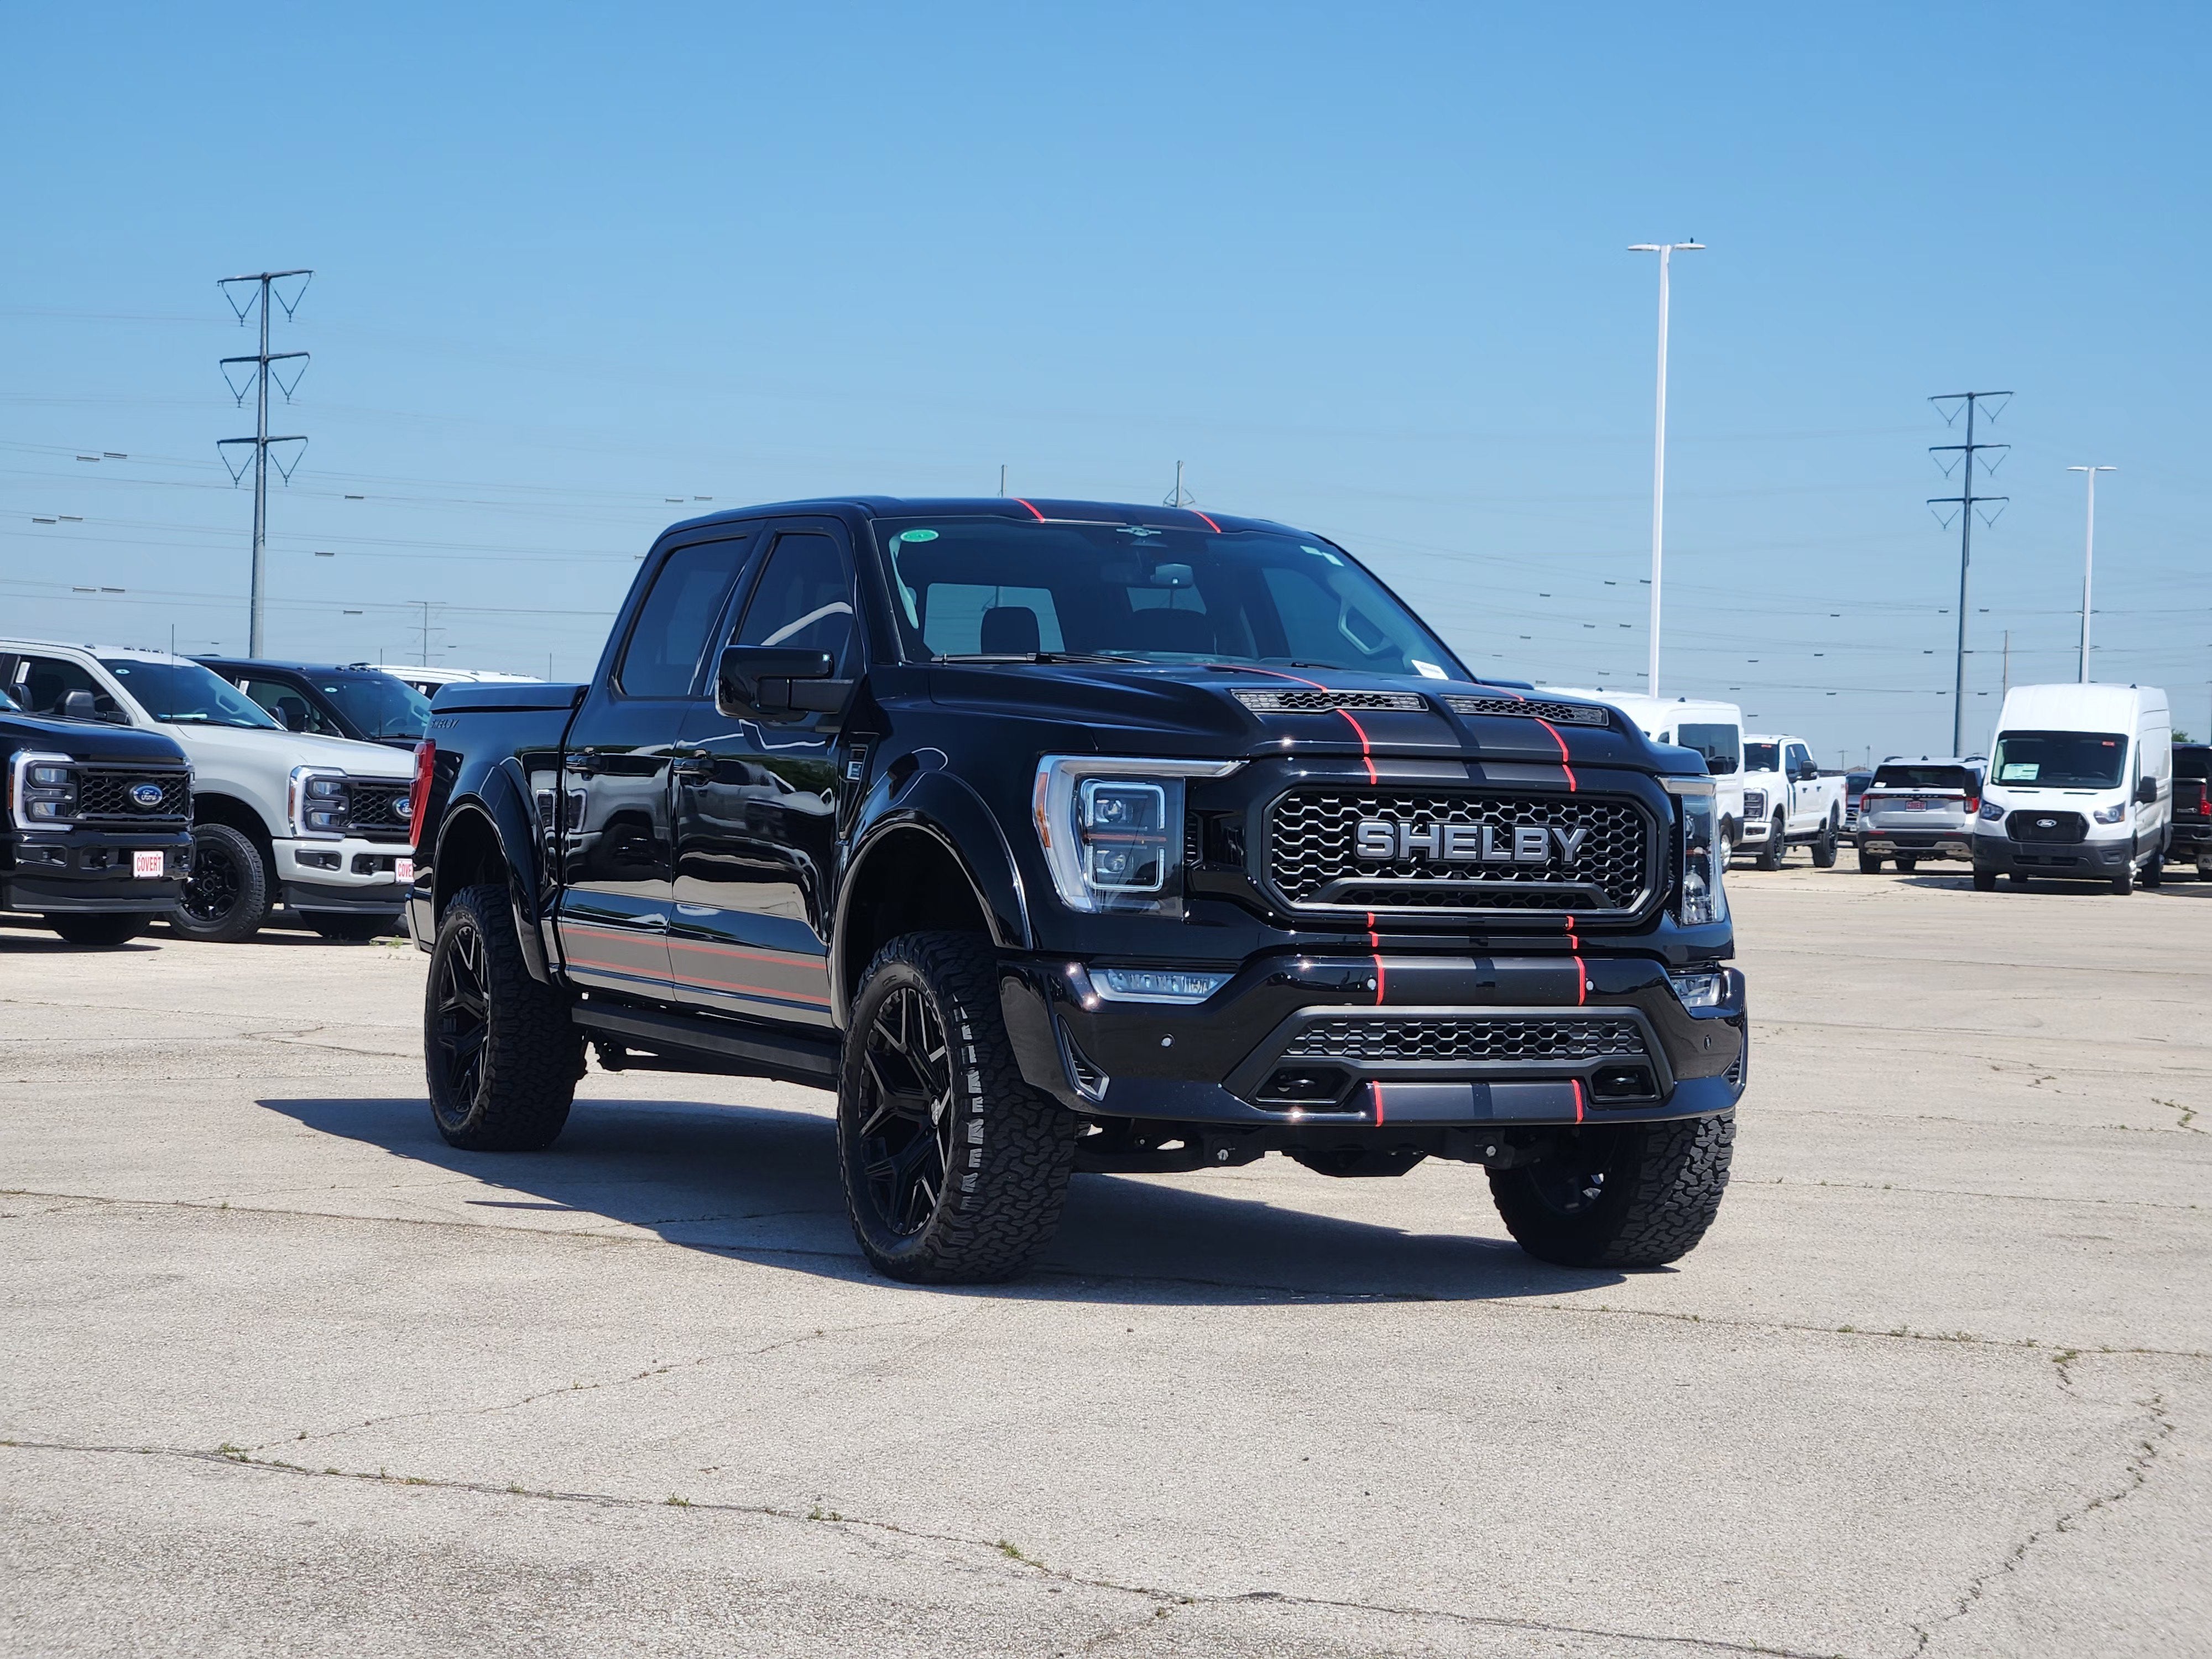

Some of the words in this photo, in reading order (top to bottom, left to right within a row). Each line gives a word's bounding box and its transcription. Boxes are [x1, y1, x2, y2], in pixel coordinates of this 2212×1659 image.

[1356, 821, 1588, 863] SHELBY
[137, 857, 161, 872] COVERT
[398, 863, 413, 877] COVE
